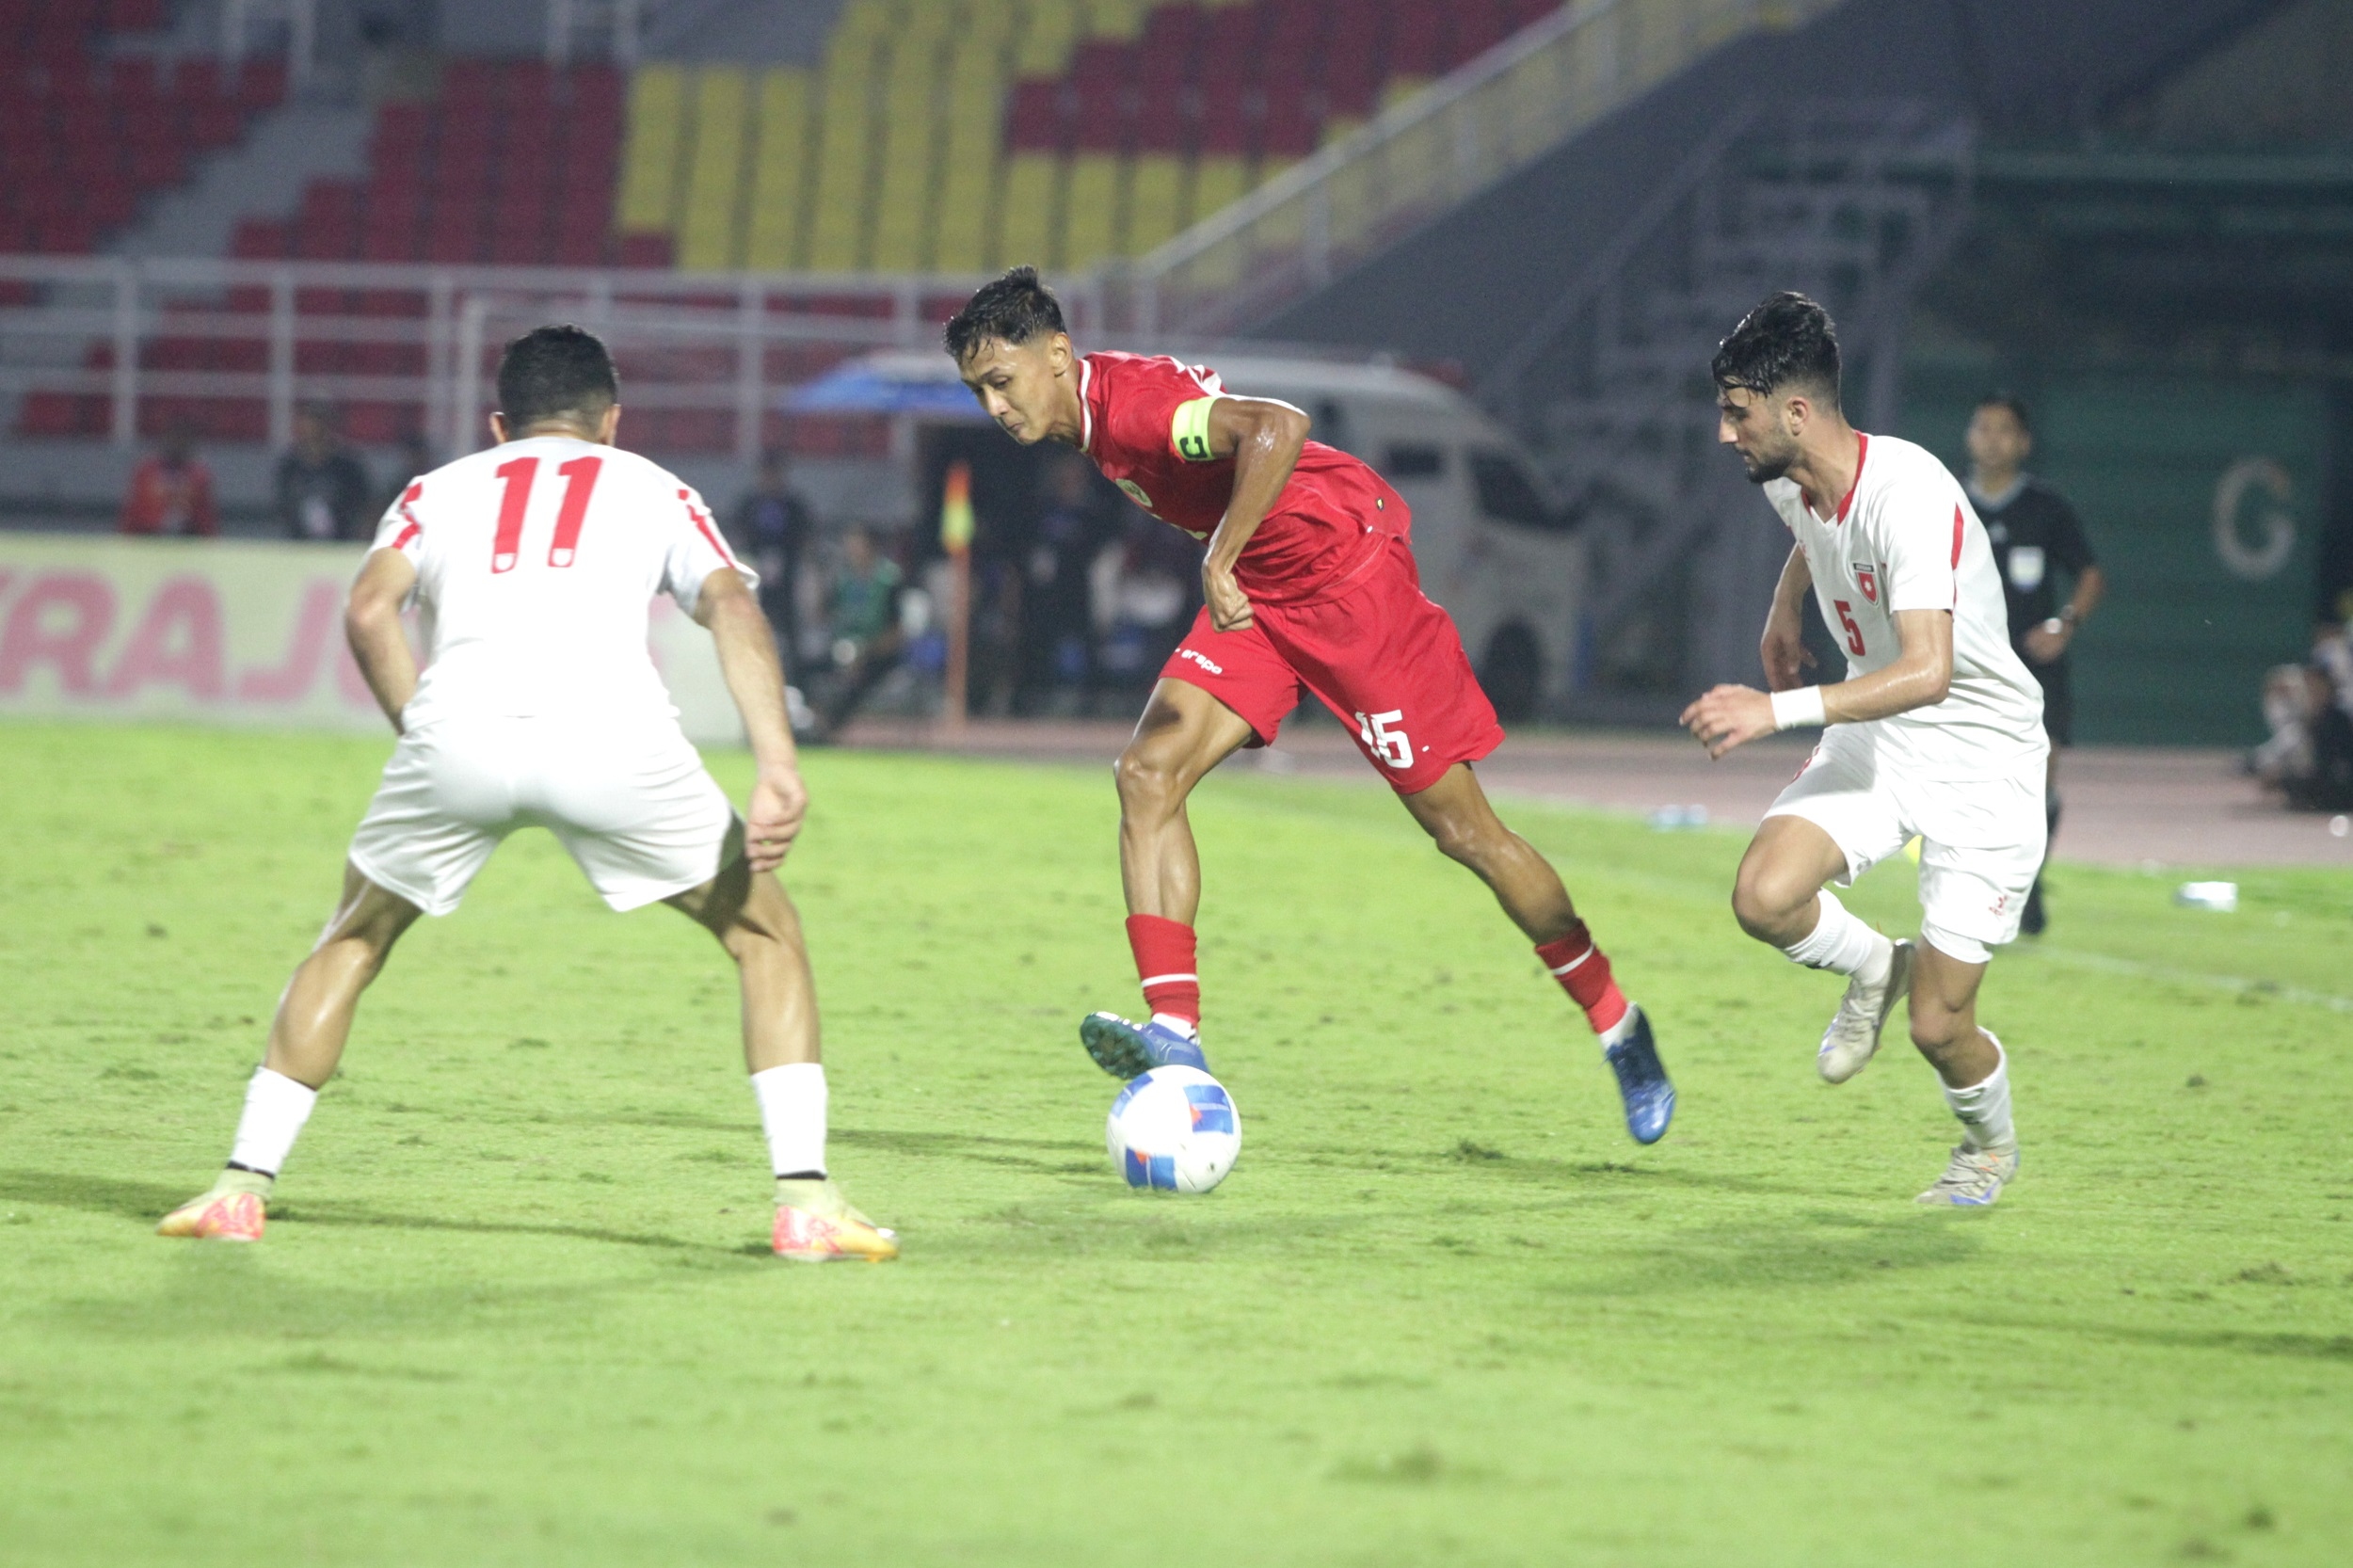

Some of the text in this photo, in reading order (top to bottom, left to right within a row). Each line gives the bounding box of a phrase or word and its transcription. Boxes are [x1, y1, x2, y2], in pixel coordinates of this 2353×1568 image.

[1179, 435, 1208, 459] C
[491, 456, 603, 574] 11
[2214, 457, 2296, 578] G
[0, 570, 384, 704] RAJ
[1833, 600, 1866, 657] 5
[1355, 709, 1415, 769] 15
